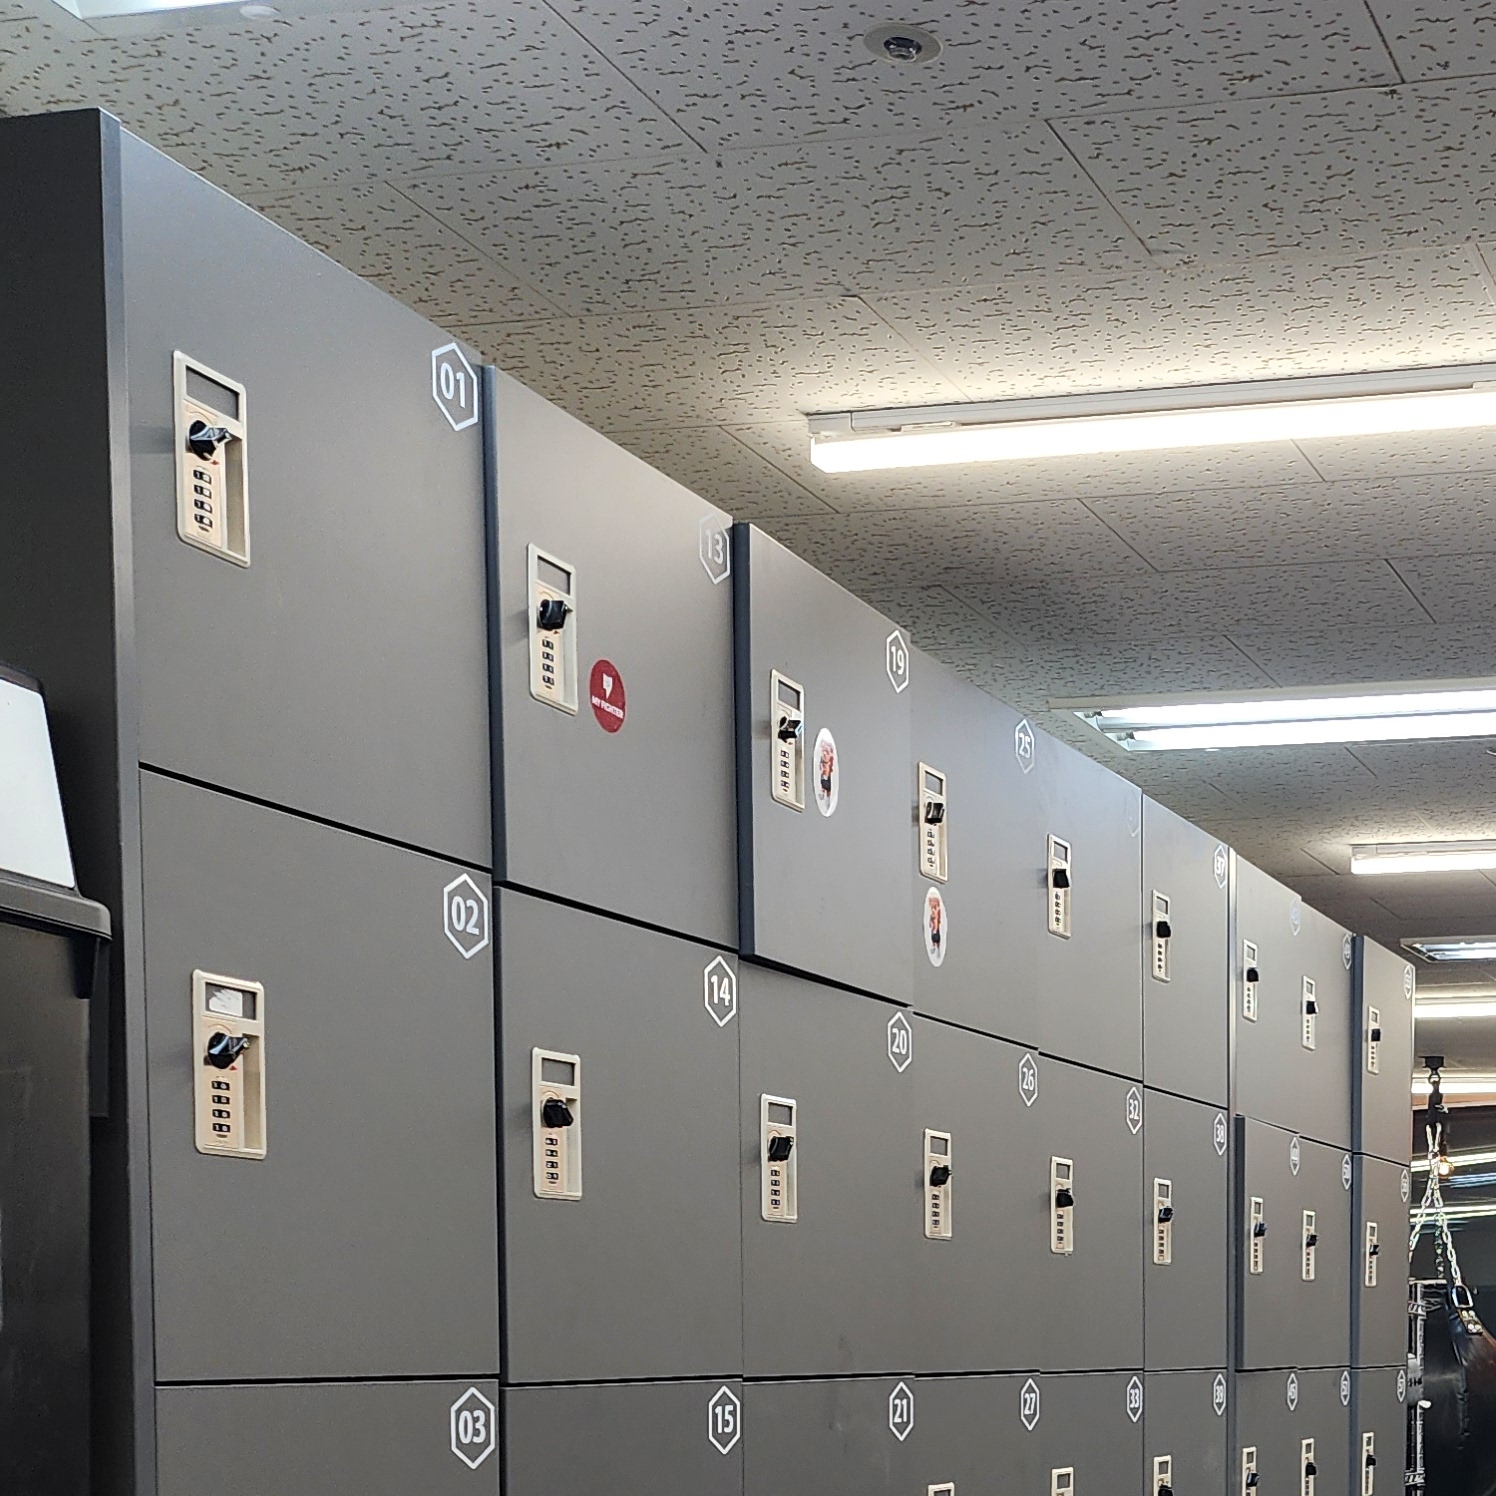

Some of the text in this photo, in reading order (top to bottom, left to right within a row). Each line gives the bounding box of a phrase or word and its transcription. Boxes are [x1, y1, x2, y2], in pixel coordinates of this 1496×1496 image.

[440, 362, 466, 408] 01
[706, 529, 724, 564] 13
[891, 646, 904, 674] 19
[451, 896, 480, 935] 02
[710, 975, 730, 1006] 14
[892, 1028, 907, 1054] 20
[1022, 1068, 1034, 1091] 26
[1129, 1098, 1139, 1120] 32
[715, 1405, 734, 1433] 15
[893, 1398, 908, 1423] 21
[459, 1410, 486, 1444] 03
